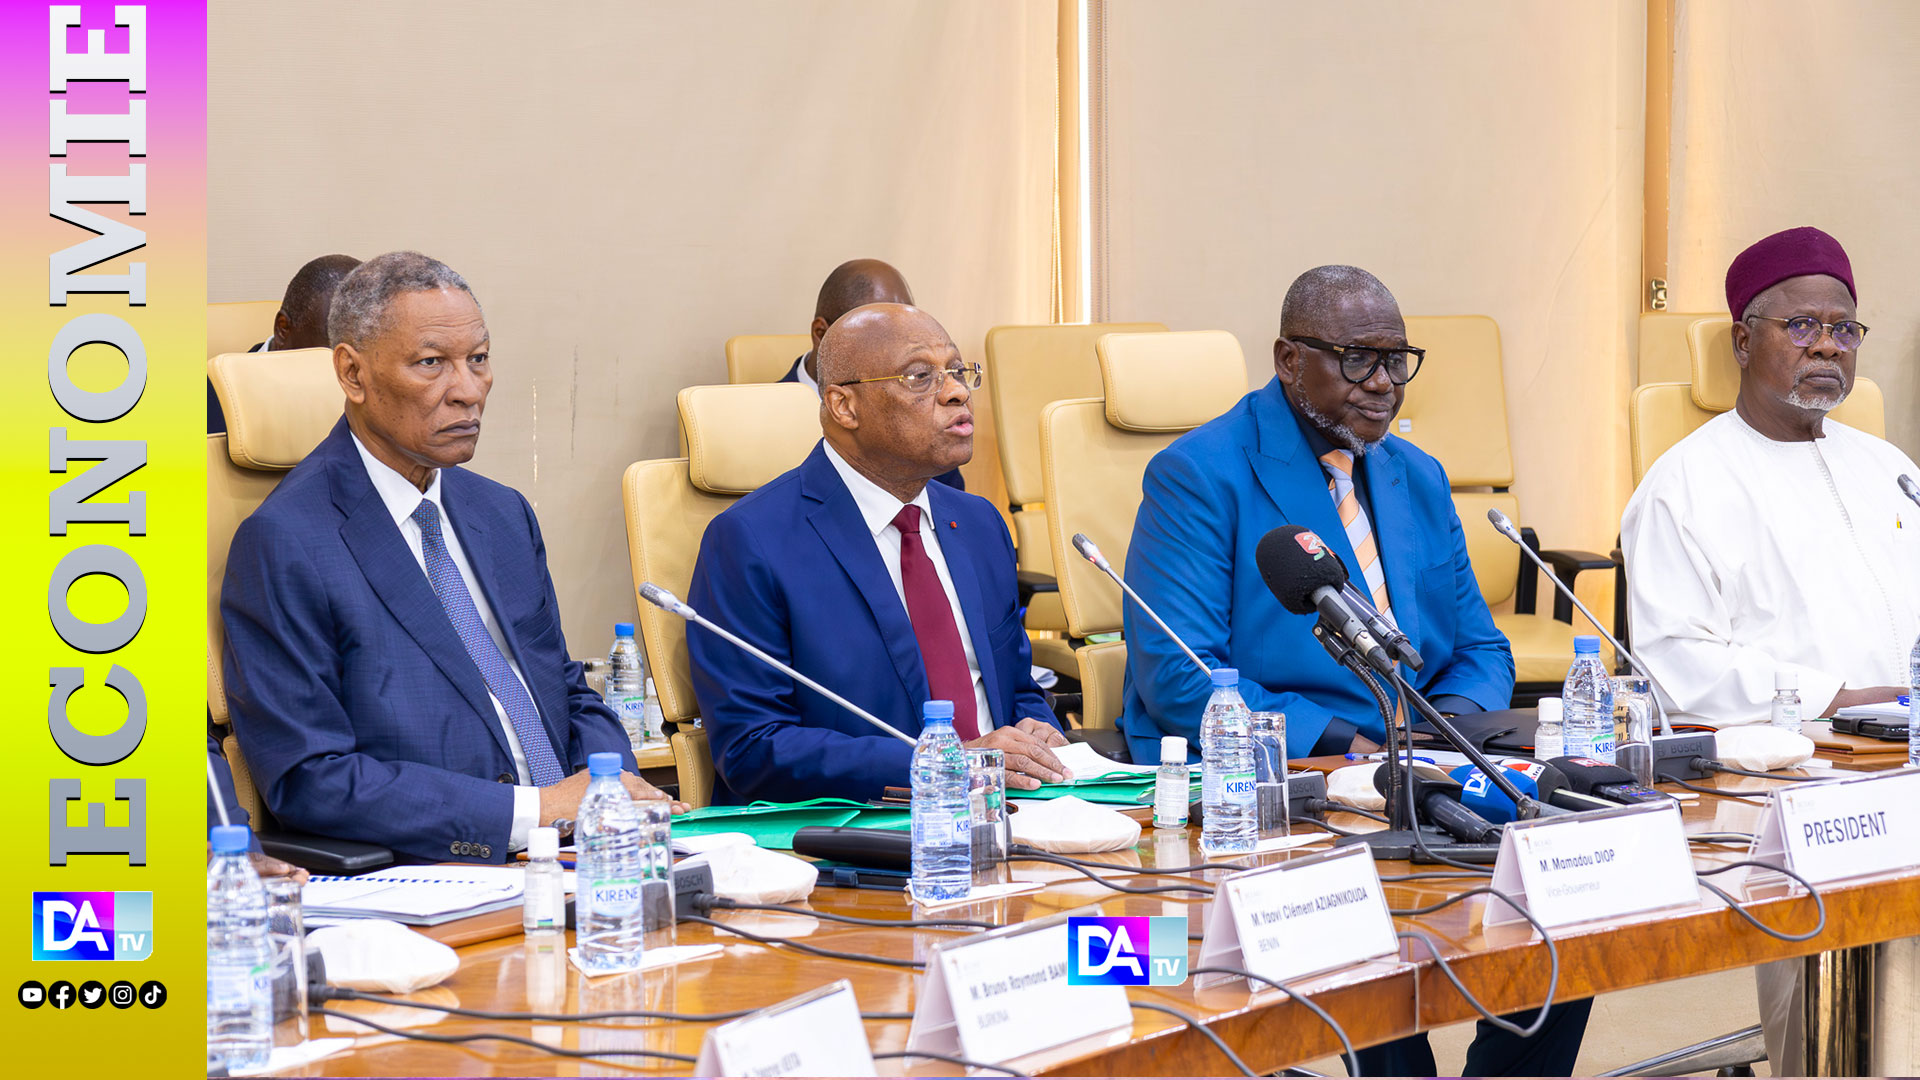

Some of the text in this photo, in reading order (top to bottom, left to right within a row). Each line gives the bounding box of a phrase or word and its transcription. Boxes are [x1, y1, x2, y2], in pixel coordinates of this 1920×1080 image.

[1670, 741, 1703, 754] BOSCH
[1804, 811, 1887, 847] PRESIDENT
[1540, 848, 1615, 872] M. Mamadou DIOP
[595, 886, 639, 902] KIRENE
